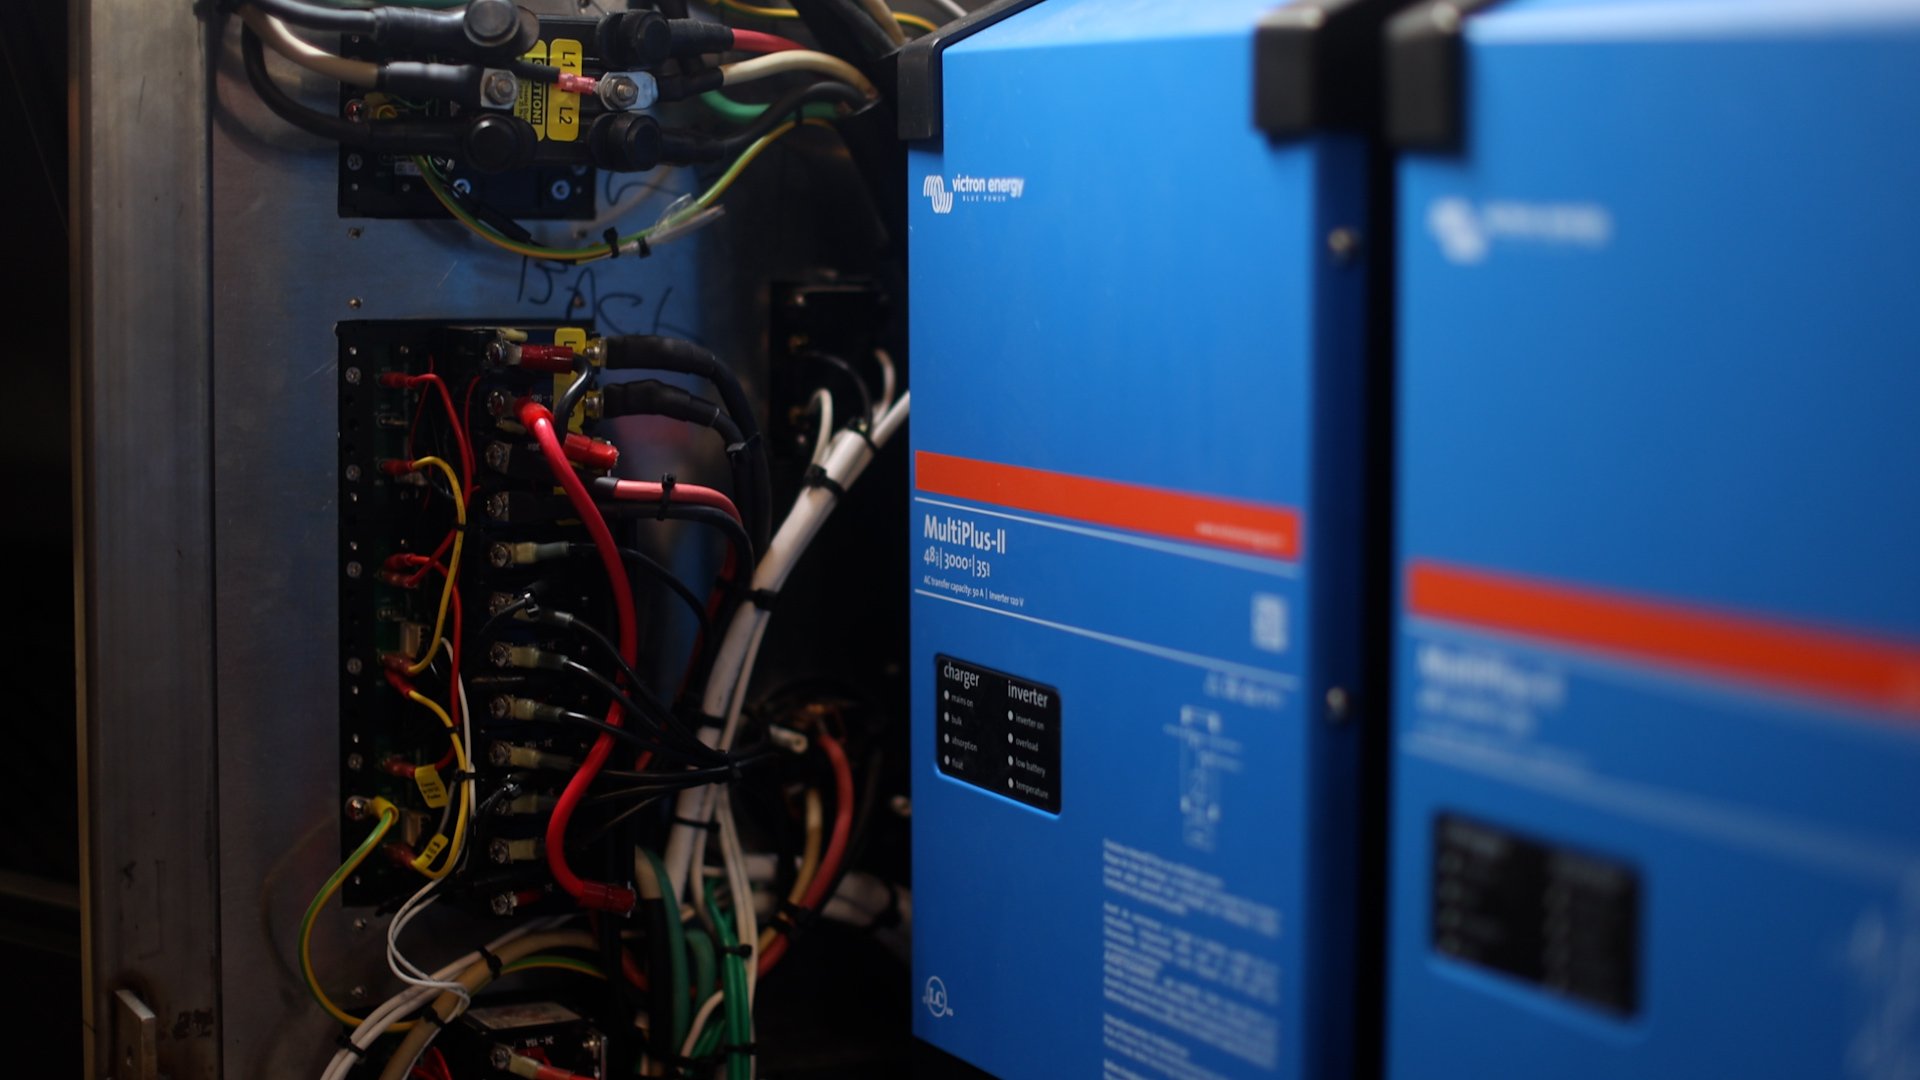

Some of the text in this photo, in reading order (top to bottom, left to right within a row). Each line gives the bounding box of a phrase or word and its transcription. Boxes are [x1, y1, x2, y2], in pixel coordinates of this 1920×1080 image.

[562, 51, 576, 68] L1
[532, 59, 543, 125] CUTION!
[559, 106, 574, 125] L2
[952, 173, 1025, 198] victron energy
[923, 513, 1006, 555] MultiPlus-II
[931, 577, 951, 589] transfer
[943, 661, 980, 690] charger
[966, 699, 974, 708] on
[1007, 680, 1048, 708] inverter
[1015, 714, 1045, 731] inverter on
[951, 736, 978, 752] absorption
[1015, 737, 1039, 752] overload
[1015, 757, 1046, 778] low battery
[1015, 779, 1049, 799] temperature
